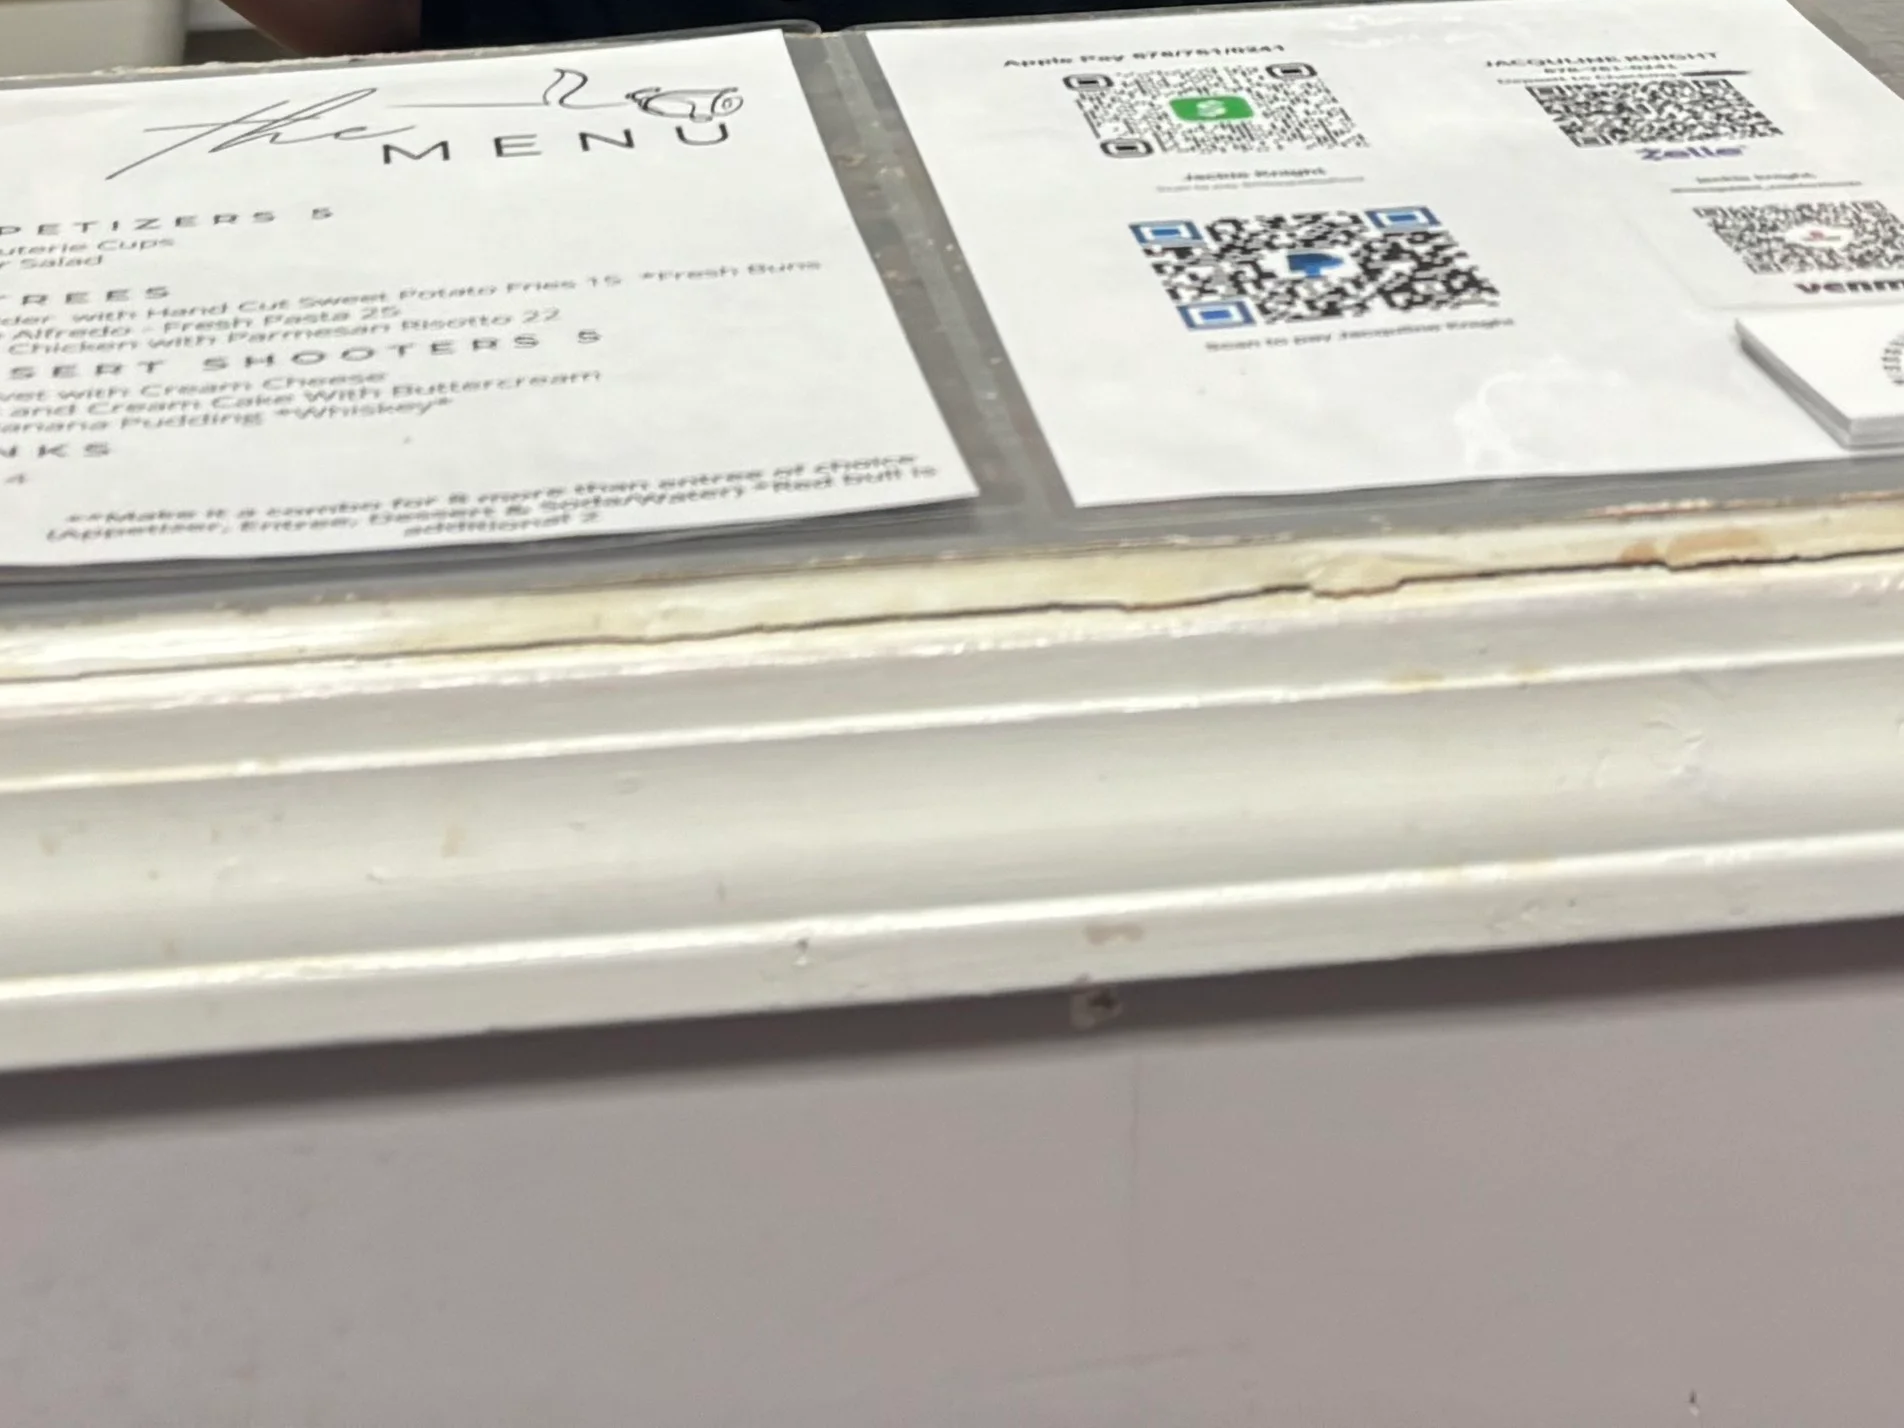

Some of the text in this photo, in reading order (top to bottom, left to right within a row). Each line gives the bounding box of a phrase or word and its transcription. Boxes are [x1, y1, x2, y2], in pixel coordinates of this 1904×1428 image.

[1003, 56, 1072, 68] Apple
[1079, 54, 1124, 64] Pay
[1623, 52, 1717, 63] KNIGHT
[381, 122, 730, 164] MENU
[95, 238, 176, 253] Cups
[20, 255, 104, 270] Salad
[72, 309, 137, 323] with
[147, 302, 228, 320] Hand
[238, 298, 291, 313] Cut
[297, 292, 387, 307] Sweet
[400, 285, 496, 300] Potato
[506, 279, 578, 294] Fries
[747, 260, 822, 275] Buns
[8, 339, 138, 356] Chicken
[149, 333, 217, 348] with
[227, 324, 391, 344] Parmesan
[400, 315, 513, 332] Risotto
[522, 307, 562, 324] 22
[13, 324, 132, 341] Alfredo
[163, 317, 253, 334] Fresh
[263, 311, 350, 327] Pasta
[202, 333, 539, 372] SHOOTERS
[10, 403, 76, 418] and
[86, 398, 200, 416] Cream
[211, 393, 295, 410] Cake
[392, 370, 601, 398] Buttercream
[58, 385, 128, 401] with
[140, 381, 252, 398] Cream
[262, 372, 385, 391] Cheese
[120, 412, 266, 431] Pudding
[266, 500, 382, 518] combo
[392, 494, 439, 510] for
[478, 486, 566, 503] more
[574, 479, 649, 497] than
[814, 454, 917, 474] choice
[404, 513, 570, 538] additional
